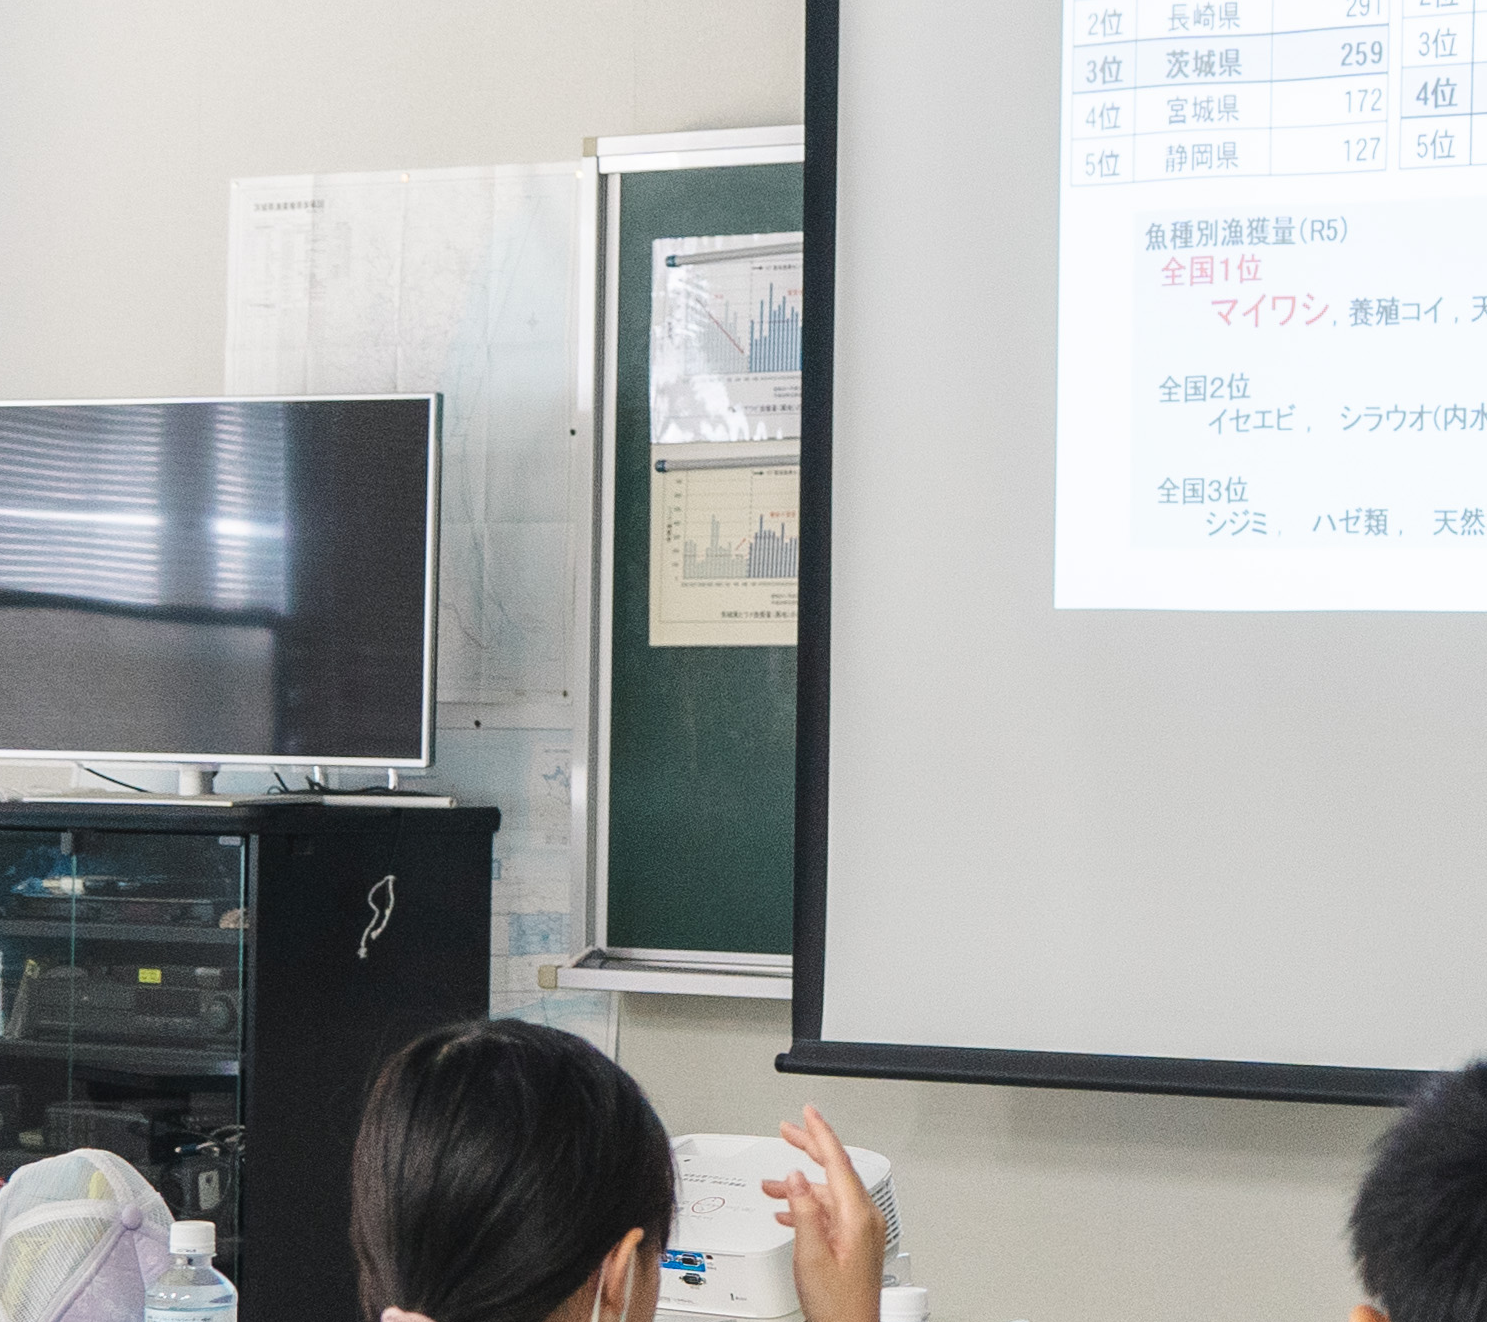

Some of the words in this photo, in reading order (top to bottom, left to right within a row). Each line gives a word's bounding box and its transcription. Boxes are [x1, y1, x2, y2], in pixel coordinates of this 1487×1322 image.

[1087, 8, 1124, 38] 2位
[1167, 0, 1241, 33] 長崎県
[1417, 27, 1458, 60] 3位
[1085, 54, 1124, 86] 3位
[1164, 47, 1243, 80] 茨城県
[1339, 39, 1385, 68] 259
[1084, 102, 1122, 132] 4位
[1166, 93, 1240, 126] 宮城県
[1344, 87, 1383, 114] 172
[1414, 76, 1459, 111] 4位
[1084, 149, 1121, 179] 5位
[1164, 140, 1240, 174] 静岡県
[1343, 135, 1382, 163] 127
[1416, 128, 1457, 161] 5位
[1160, 253, 1262, 287] 全国1位
[1157, 371, 1252, 405] 全国2位
[1156, 475, 1250, 506] 全国3位
